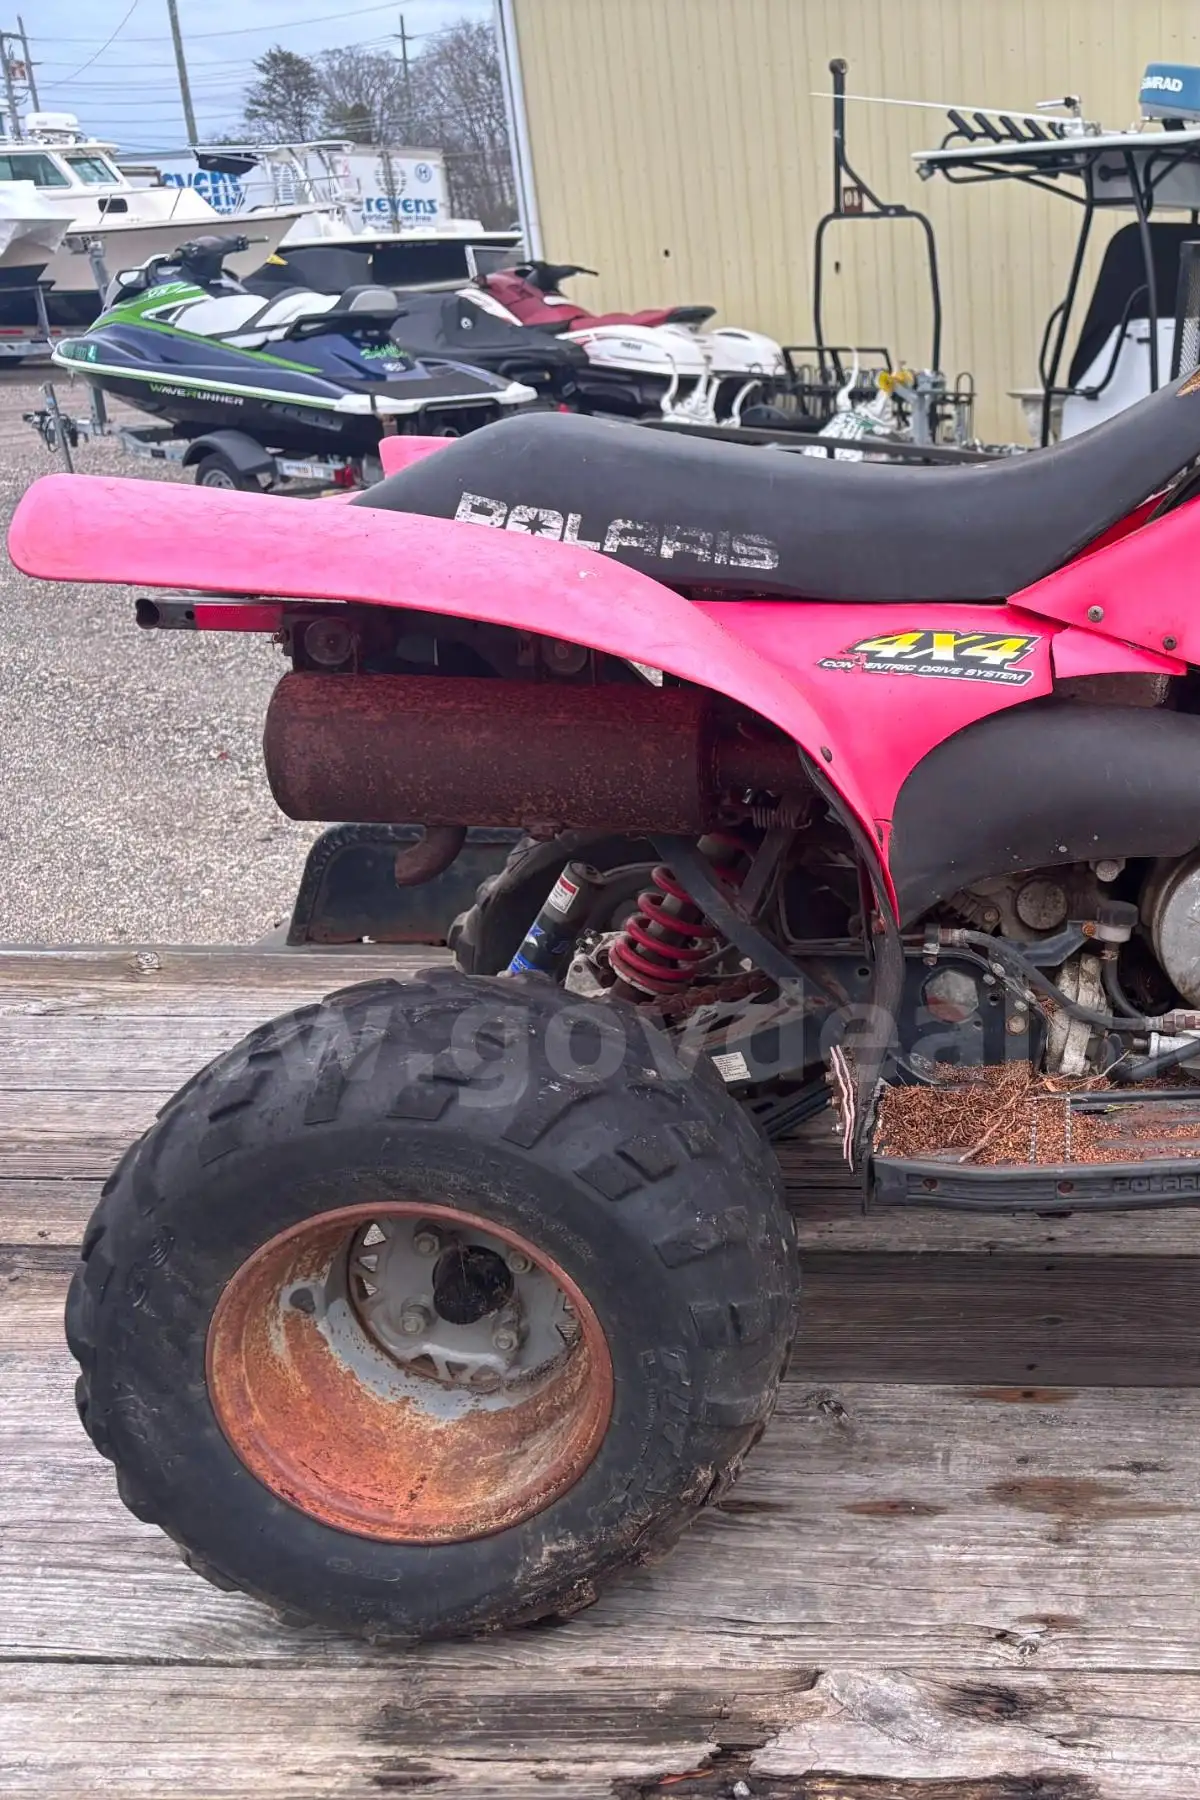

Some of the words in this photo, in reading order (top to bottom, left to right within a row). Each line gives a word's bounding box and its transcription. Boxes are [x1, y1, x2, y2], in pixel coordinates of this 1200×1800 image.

[149, 382, 244, 406] WAVERUNNER
[453, 491, 779, 570] POLARIS
[850, 632, 1029, 665] 4X4
[917, 664, 963, 676] DRIVE
[963, 668, 1025, 682] SYSTEM
